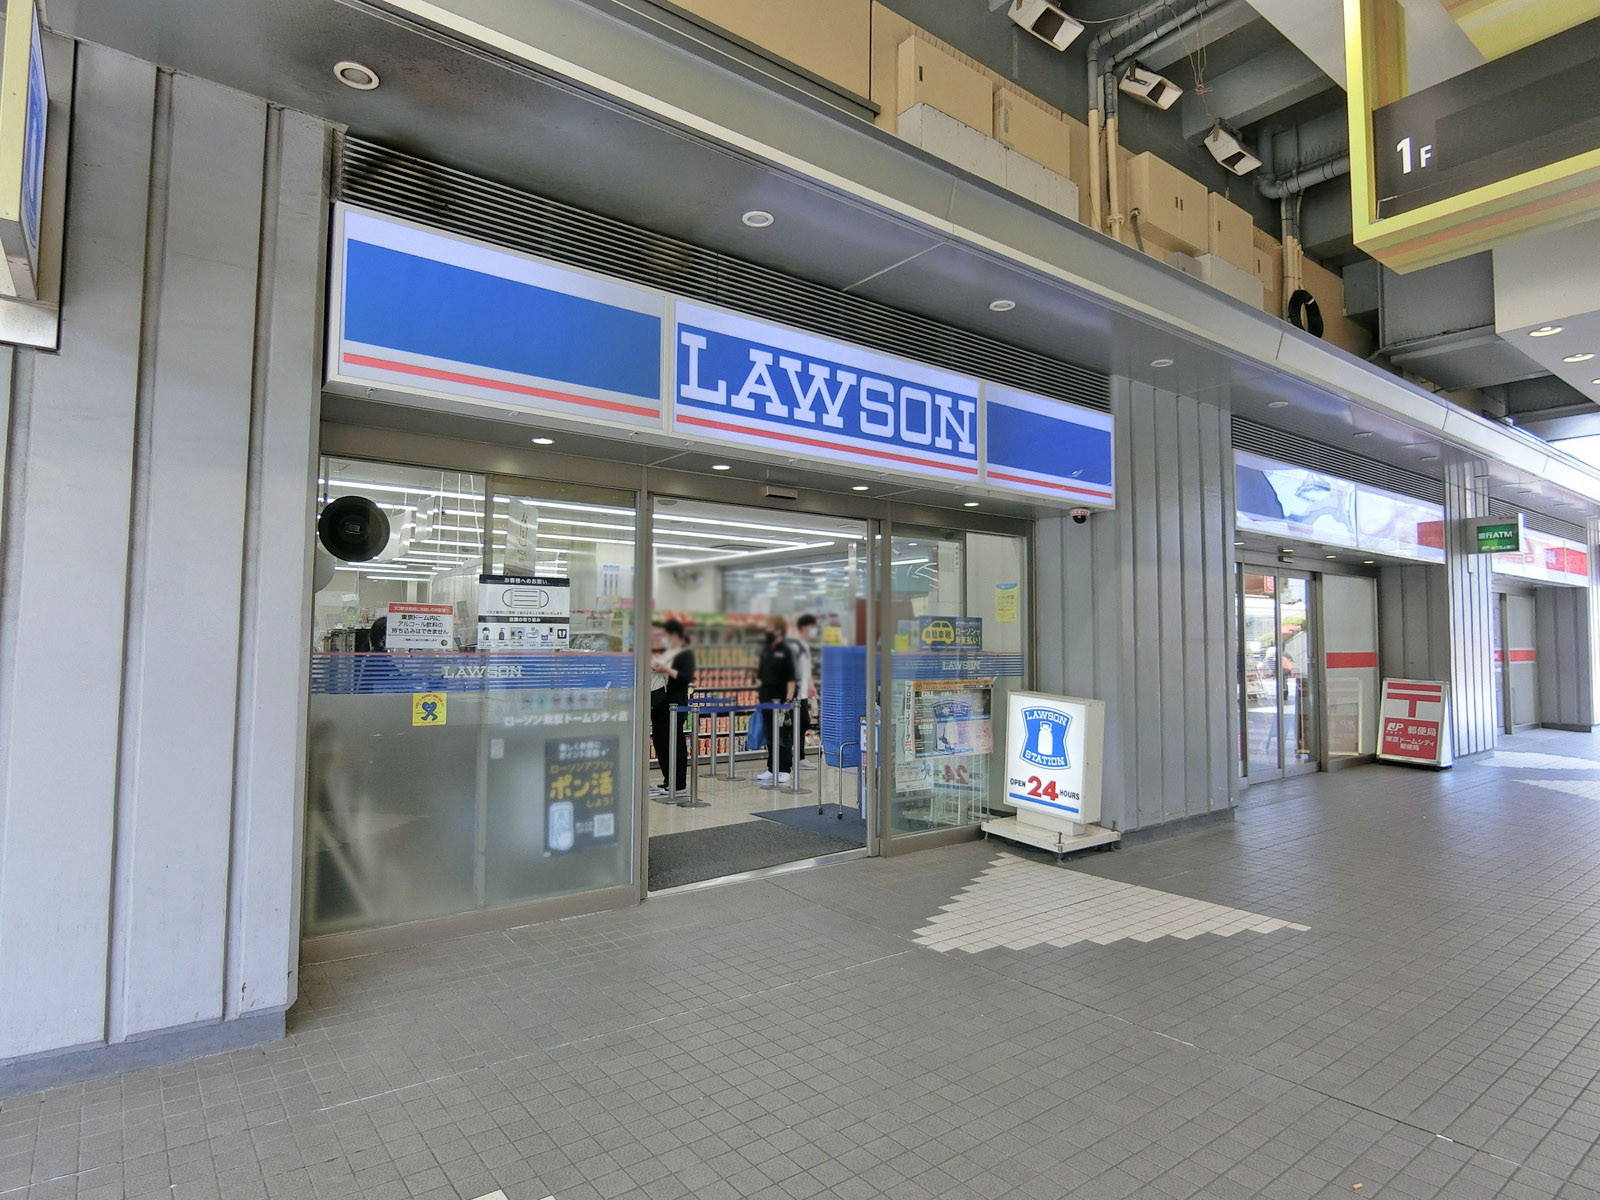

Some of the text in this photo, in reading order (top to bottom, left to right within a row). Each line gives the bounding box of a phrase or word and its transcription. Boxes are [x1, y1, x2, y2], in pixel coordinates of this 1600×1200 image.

[680, 331, 976, 455] LAWSON
[401, 614, 441, 622] 東京ドーム内に
[391, 627, 449, 635] 持ち込みはできません
[443, 665, 524, 679] LAWSON
[1026, 710, 1067, 726] LAWSON
[1407, 726, 1437, 737] 郵便局
[1025, 749, 1065, 766] STATION
[549, 770, 613, 800] ポン活
[1009, 776, 1080, 801] OPEN 24 HOURS
